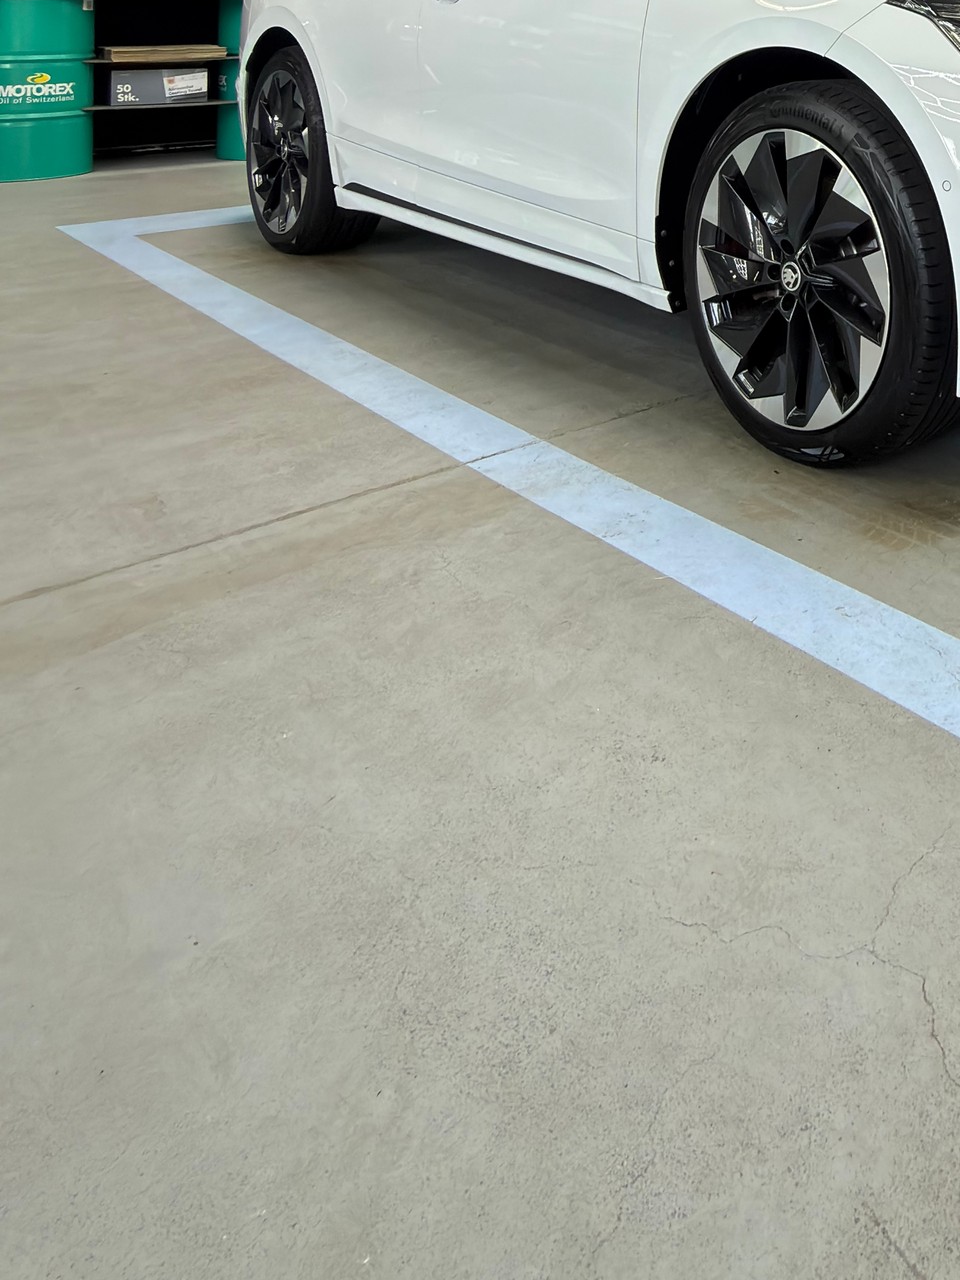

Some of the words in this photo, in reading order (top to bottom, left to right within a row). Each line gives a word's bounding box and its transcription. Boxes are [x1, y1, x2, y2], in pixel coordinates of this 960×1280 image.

[0, 82, 75, 97] MOTOREX
[116, 84, 131, 93] 50
[26, 95, 75, 103] Switzerland
[117, 93, 139, 102] Stk.
